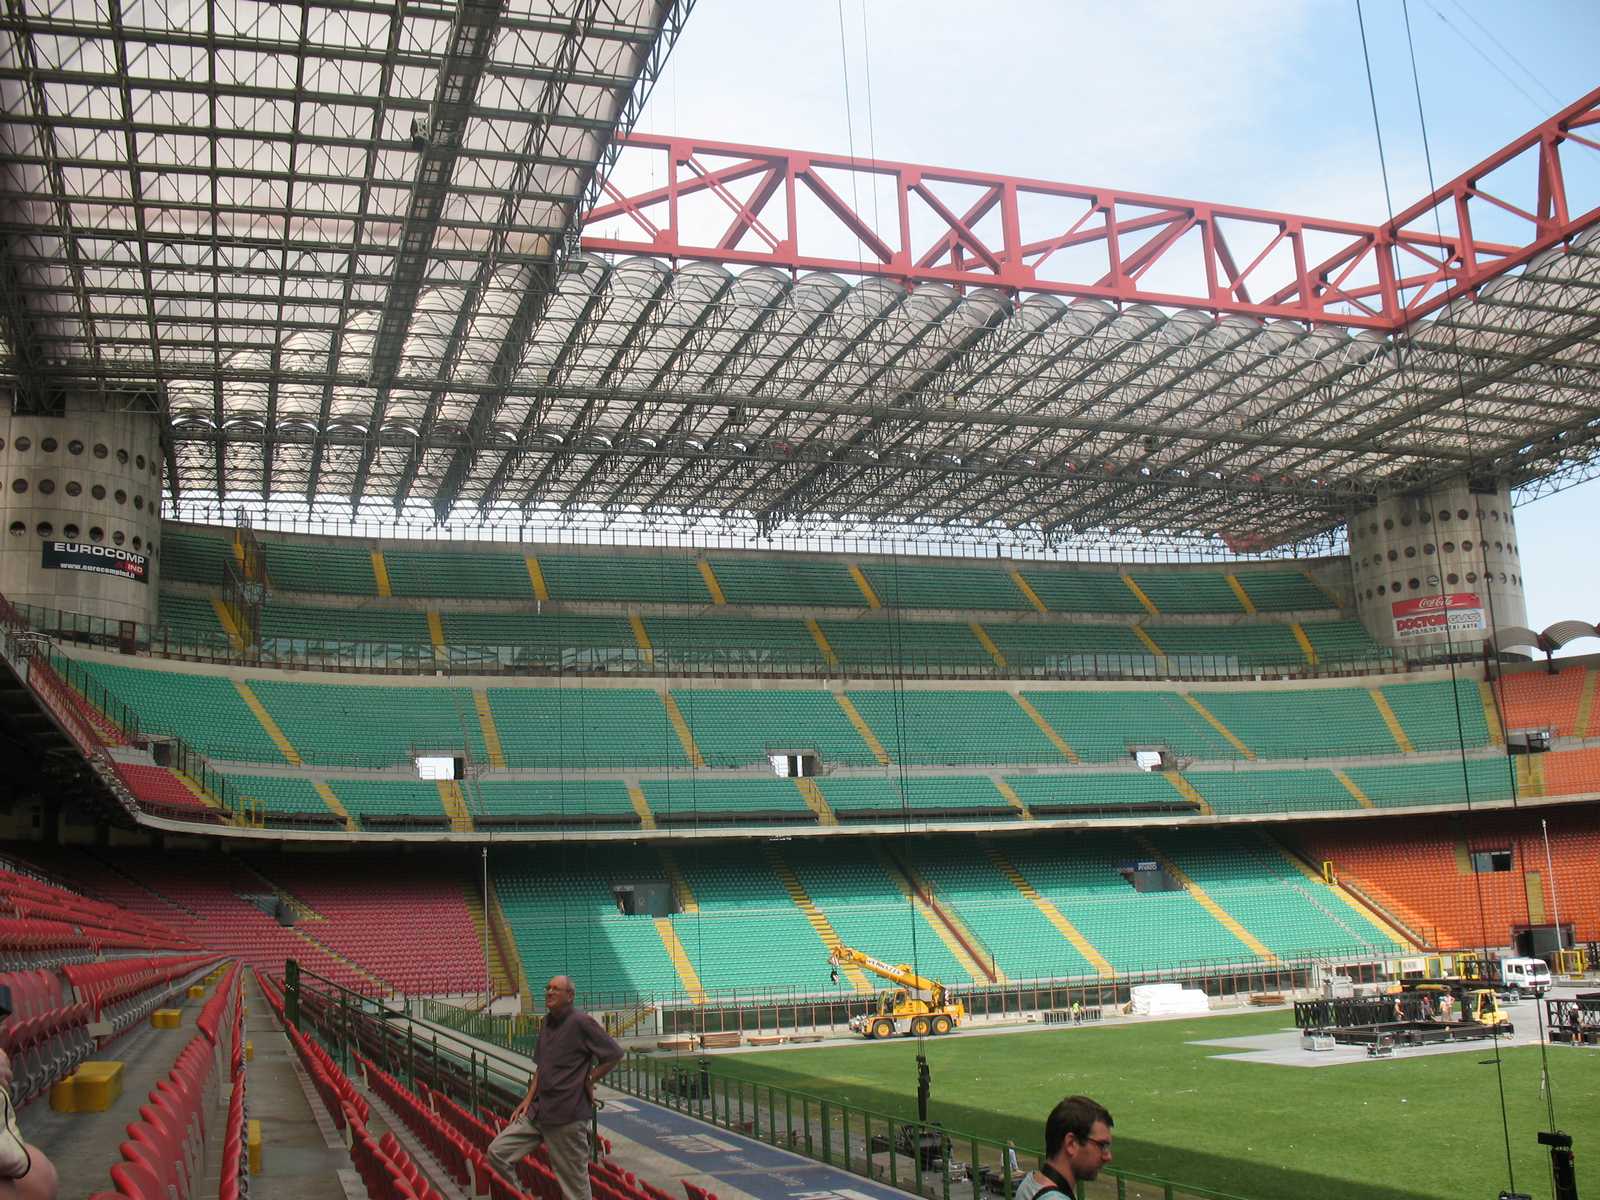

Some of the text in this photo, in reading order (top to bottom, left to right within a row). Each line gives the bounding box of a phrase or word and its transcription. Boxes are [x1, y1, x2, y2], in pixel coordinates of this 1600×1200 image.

[54, 542, 145, 564] EUROCOMP
[127, 563, 143, 573] IND
[1396, 614, 1446, 632] DOCTOR
